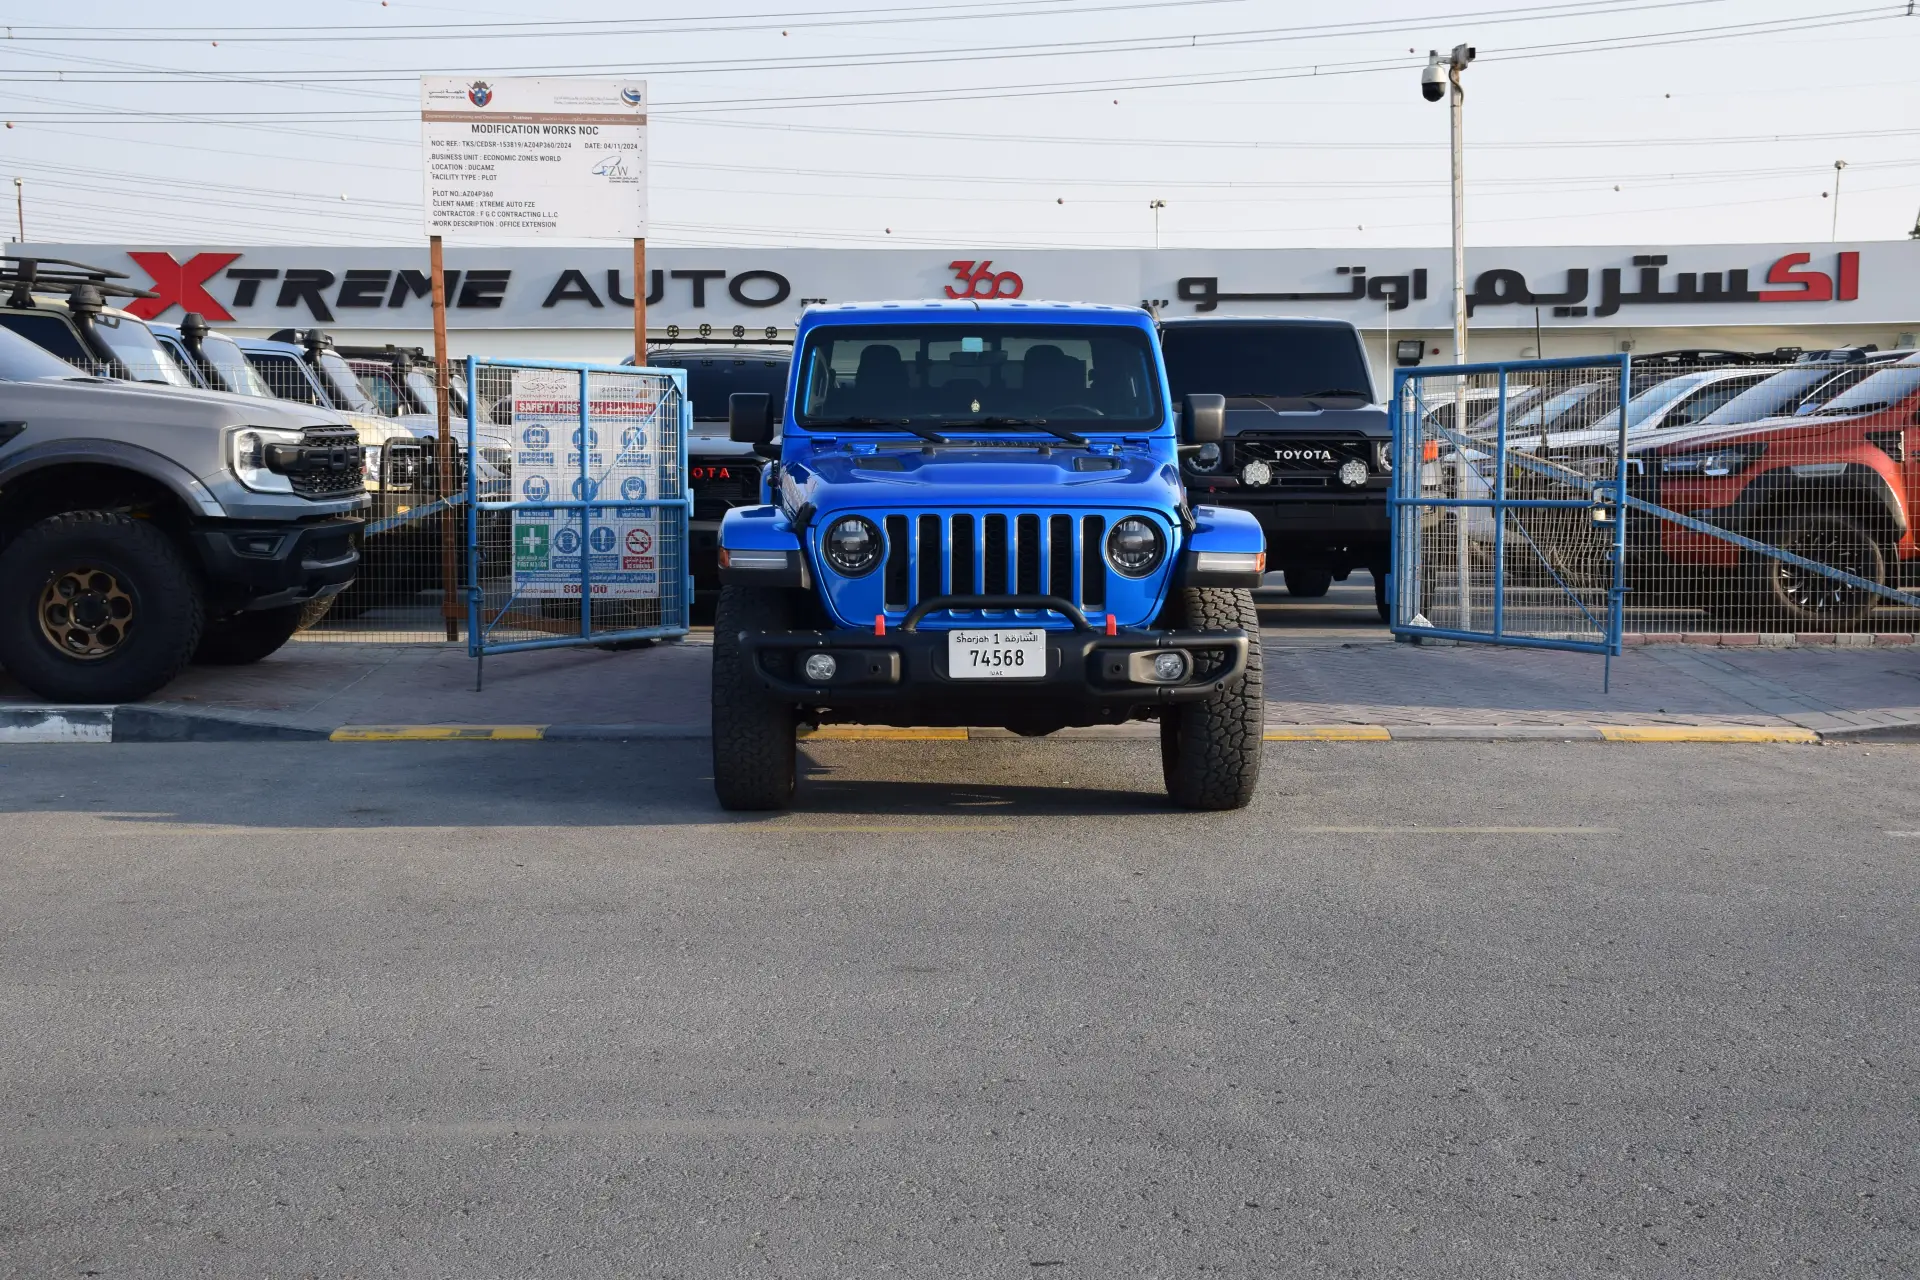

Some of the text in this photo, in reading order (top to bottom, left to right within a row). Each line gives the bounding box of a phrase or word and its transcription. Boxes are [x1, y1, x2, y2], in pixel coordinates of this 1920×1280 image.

[472, 124, 599, 135] MODIFICATION WORKS NOC
[602, 166, 628, 176] EZW
[944, 260, 1024, 300] 360
[122, 251, 791, 322] XTREME AUTO
[520, 403, 580, 412] SAFETY FIRS
[1274, 450, 1331, 460] TOYOTA
[956, 634, 1000, 644] Sharjah 1
[1005, 633, 1038, 644] الشارقة
[970, 650, 1024, 666] 74568
